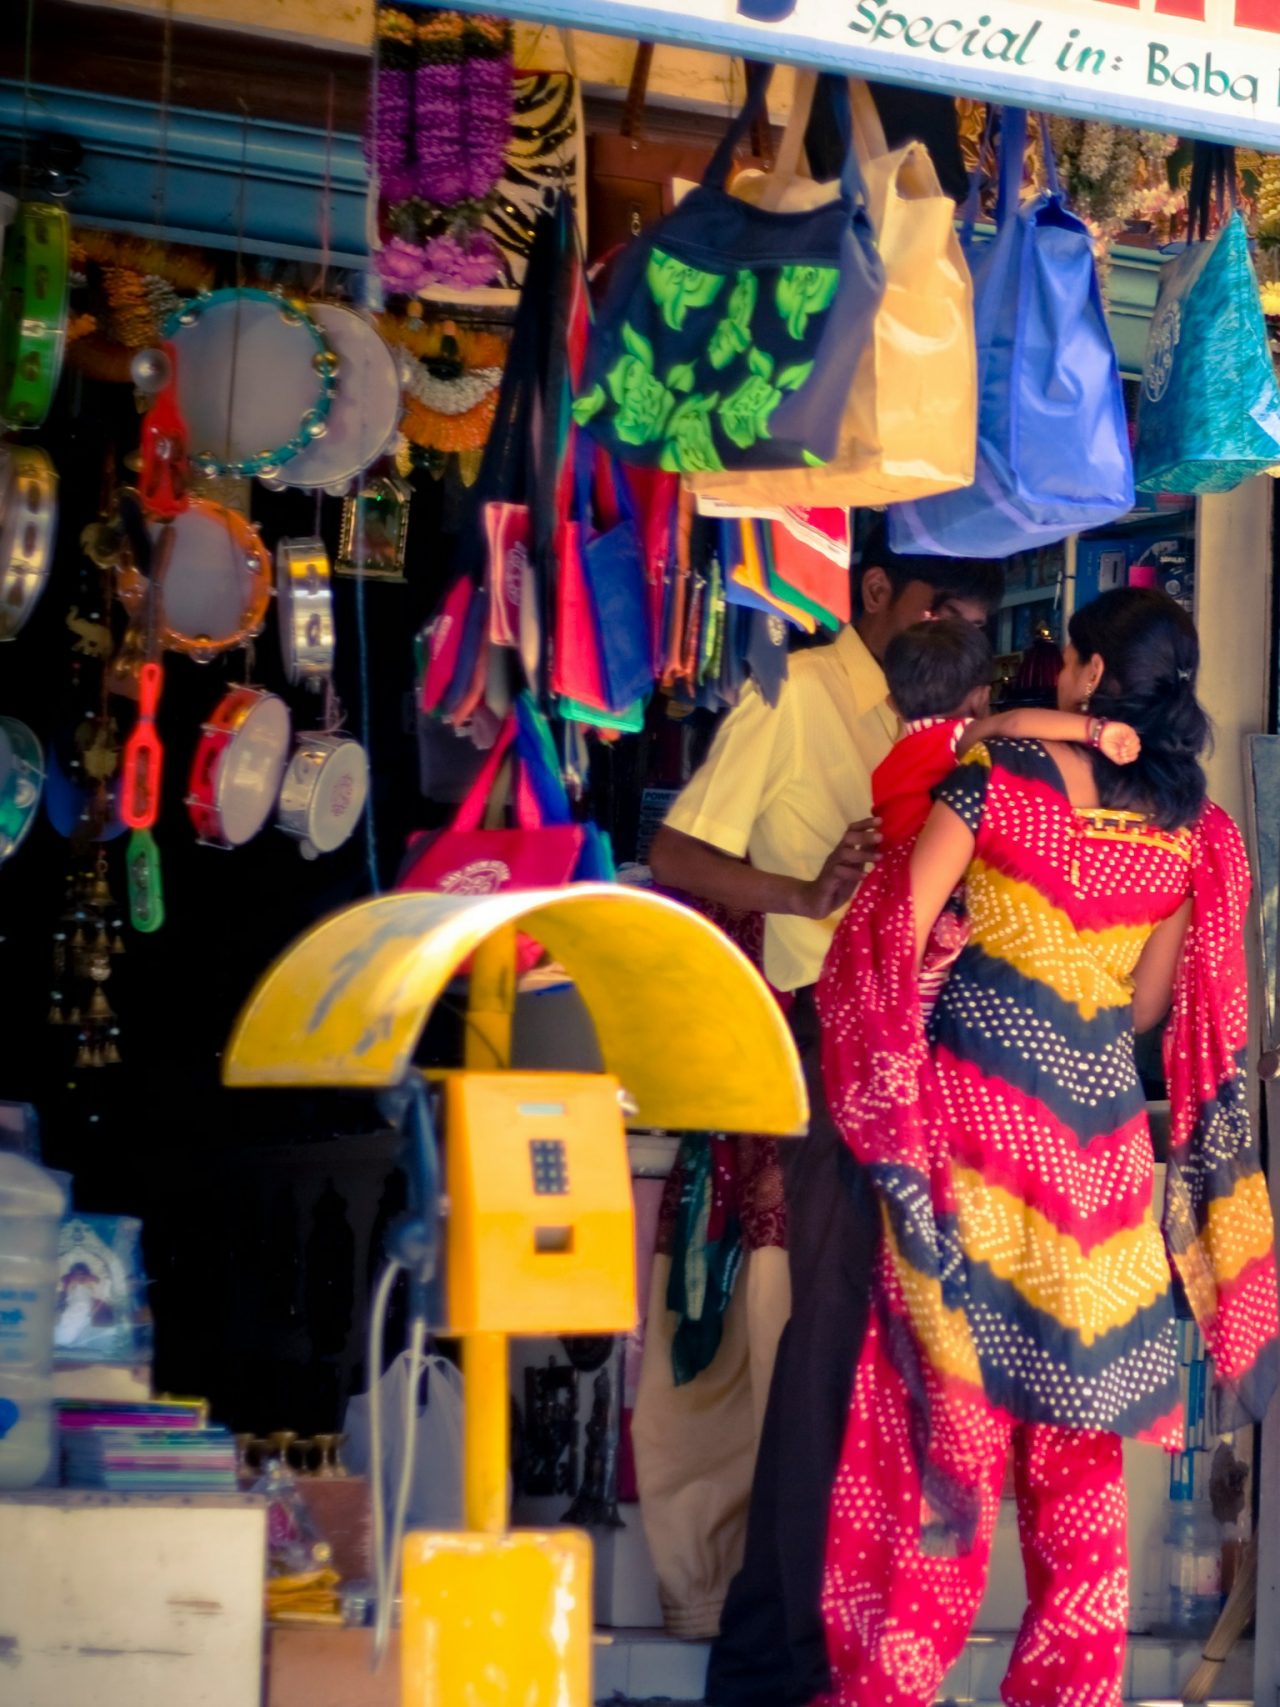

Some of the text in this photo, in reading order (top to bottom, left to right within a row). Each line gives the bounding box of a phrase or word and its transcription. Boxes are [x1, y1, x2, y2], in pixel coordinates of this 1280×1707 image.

[847, 0, 1043, 65] Special
[1056, 28, 1124, 75] in:
[1146, 42, 1259, 103] Baba
